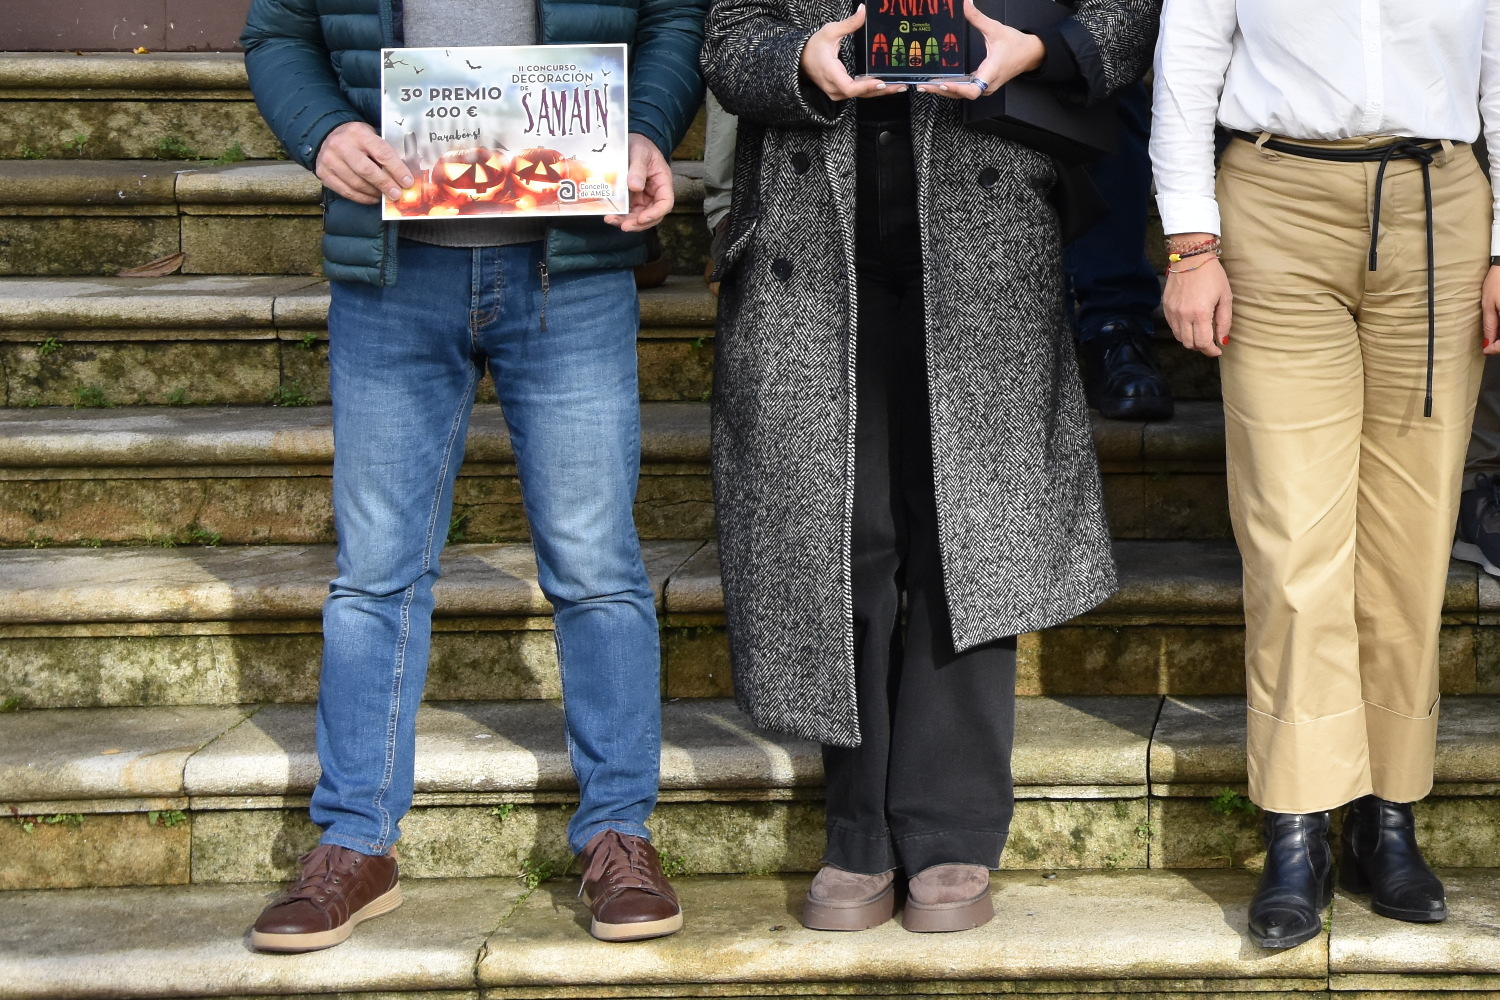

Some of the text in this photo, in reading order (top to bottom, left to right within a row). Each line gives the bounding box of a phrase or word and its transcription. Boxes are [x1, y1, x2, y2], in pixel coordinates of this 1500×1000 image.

[526, 64, 577, 72] CONCURSO
[511, 70, 594, 84] DECORACIÓN
[429, 86, 502, 101] PREMIO
[425, 105, 478, 118] 400 €
[429, 128, 481, 143] Parabéns!
[580, 182, 609, 190] Concello
